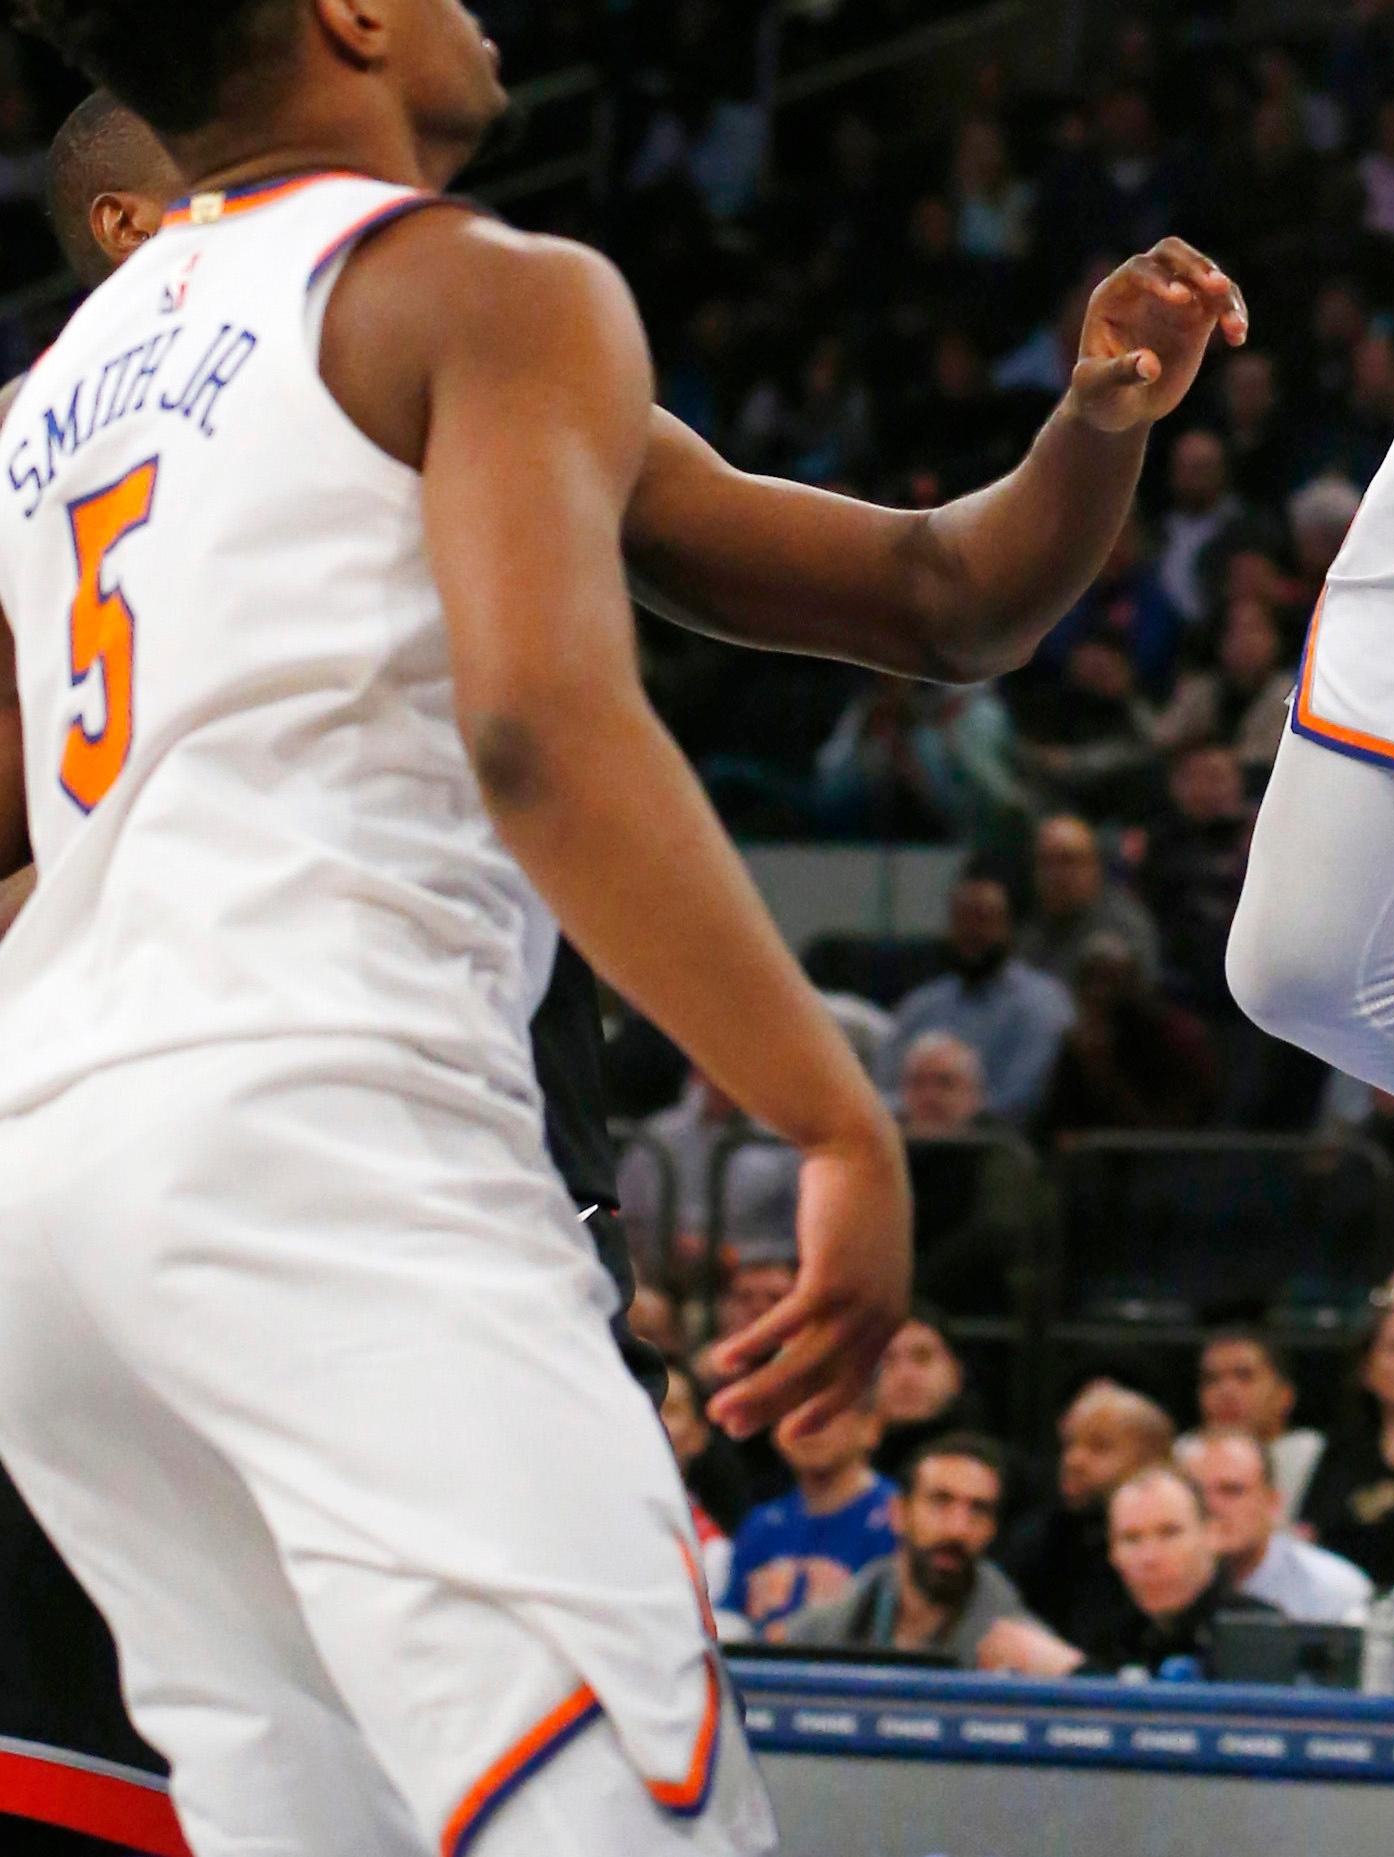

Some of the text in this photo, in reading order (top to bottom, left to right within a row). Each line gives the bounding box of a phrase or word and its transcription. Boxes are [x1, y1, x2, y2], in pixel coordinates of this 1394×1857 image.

[8, 323, 258, 519] SMITH JR
[58, 454, 160, 816] 5
